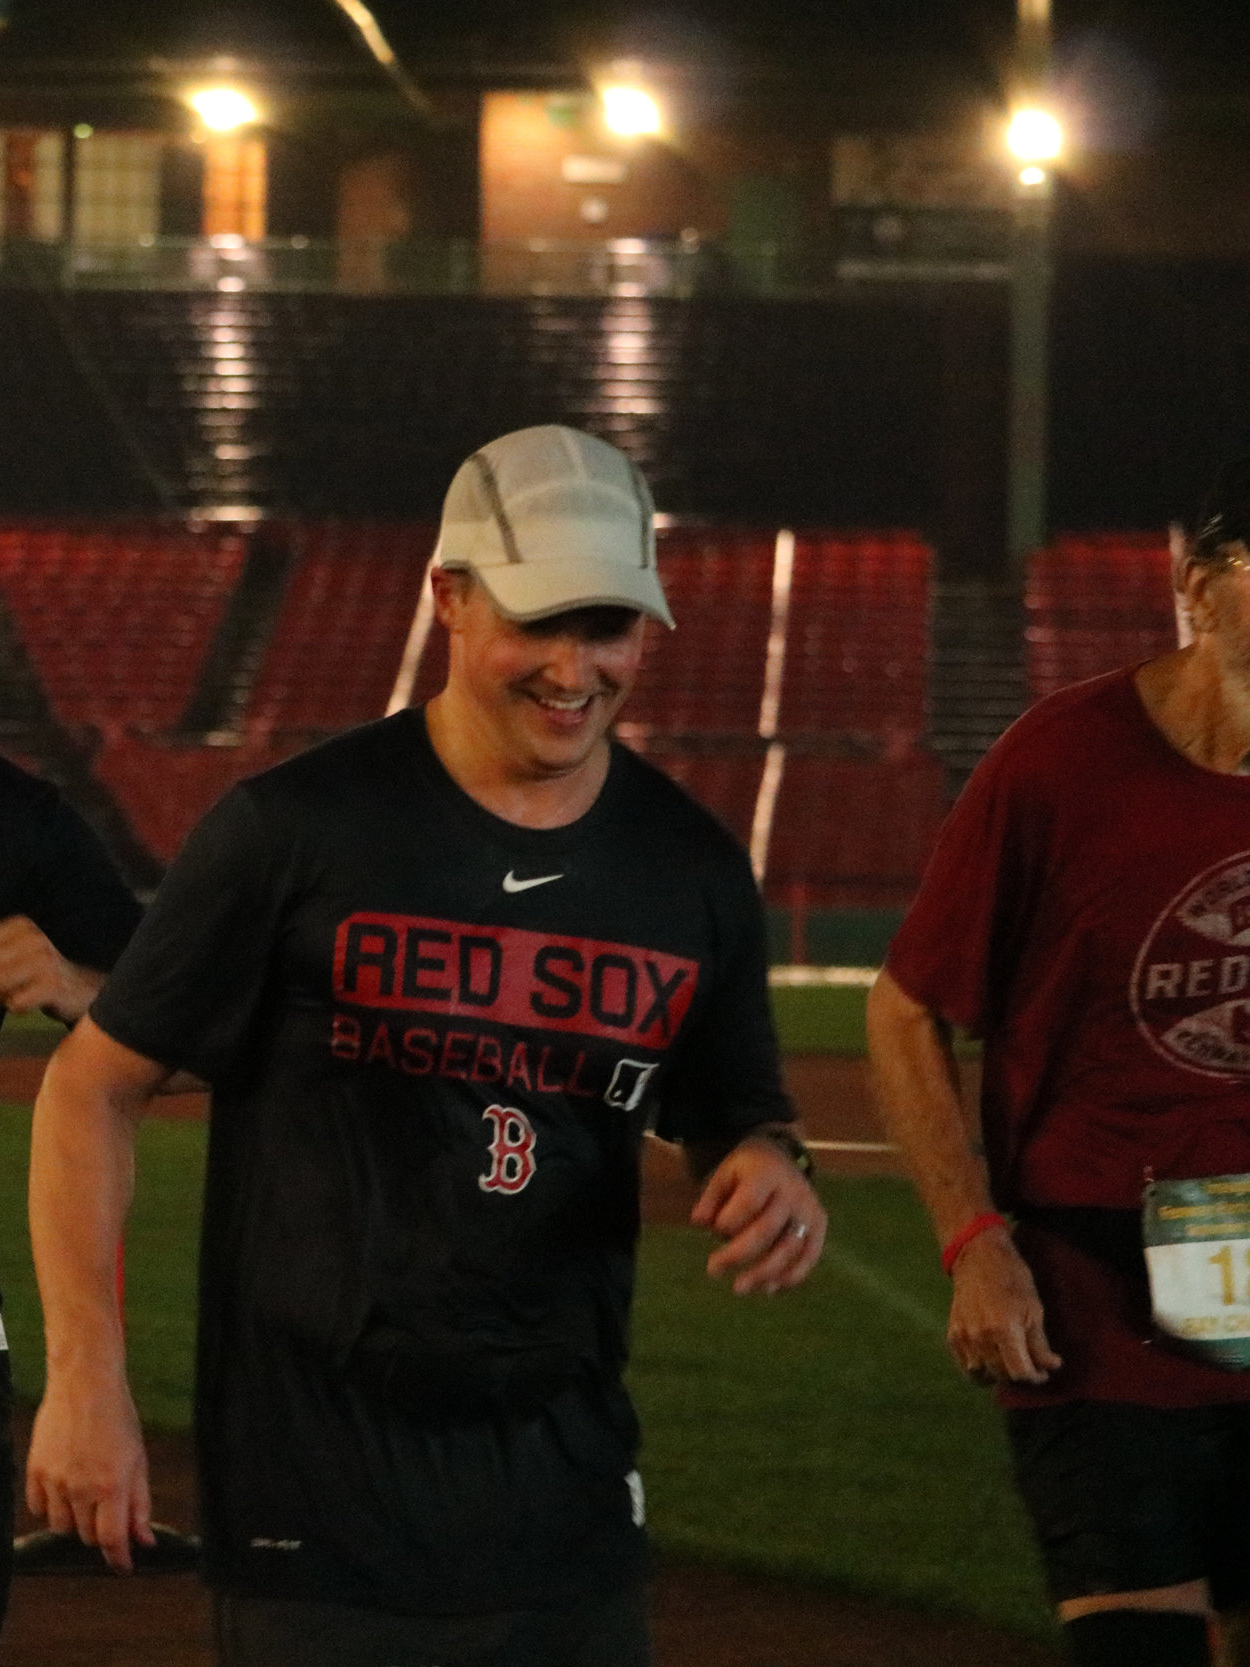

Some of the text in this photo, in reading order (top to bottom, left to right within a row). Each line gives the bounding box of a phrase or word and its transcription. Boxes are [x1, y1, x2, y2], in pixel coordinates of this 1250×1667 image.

[343, 922, 687, 1041] RED SOX
[1145, 955, 1250, 1000] RED
[331, 1013, 597, 1098] BASEBALL
[478, 1103, 537, 1195] B
[1207, 1244, 1250, 1307] 1
